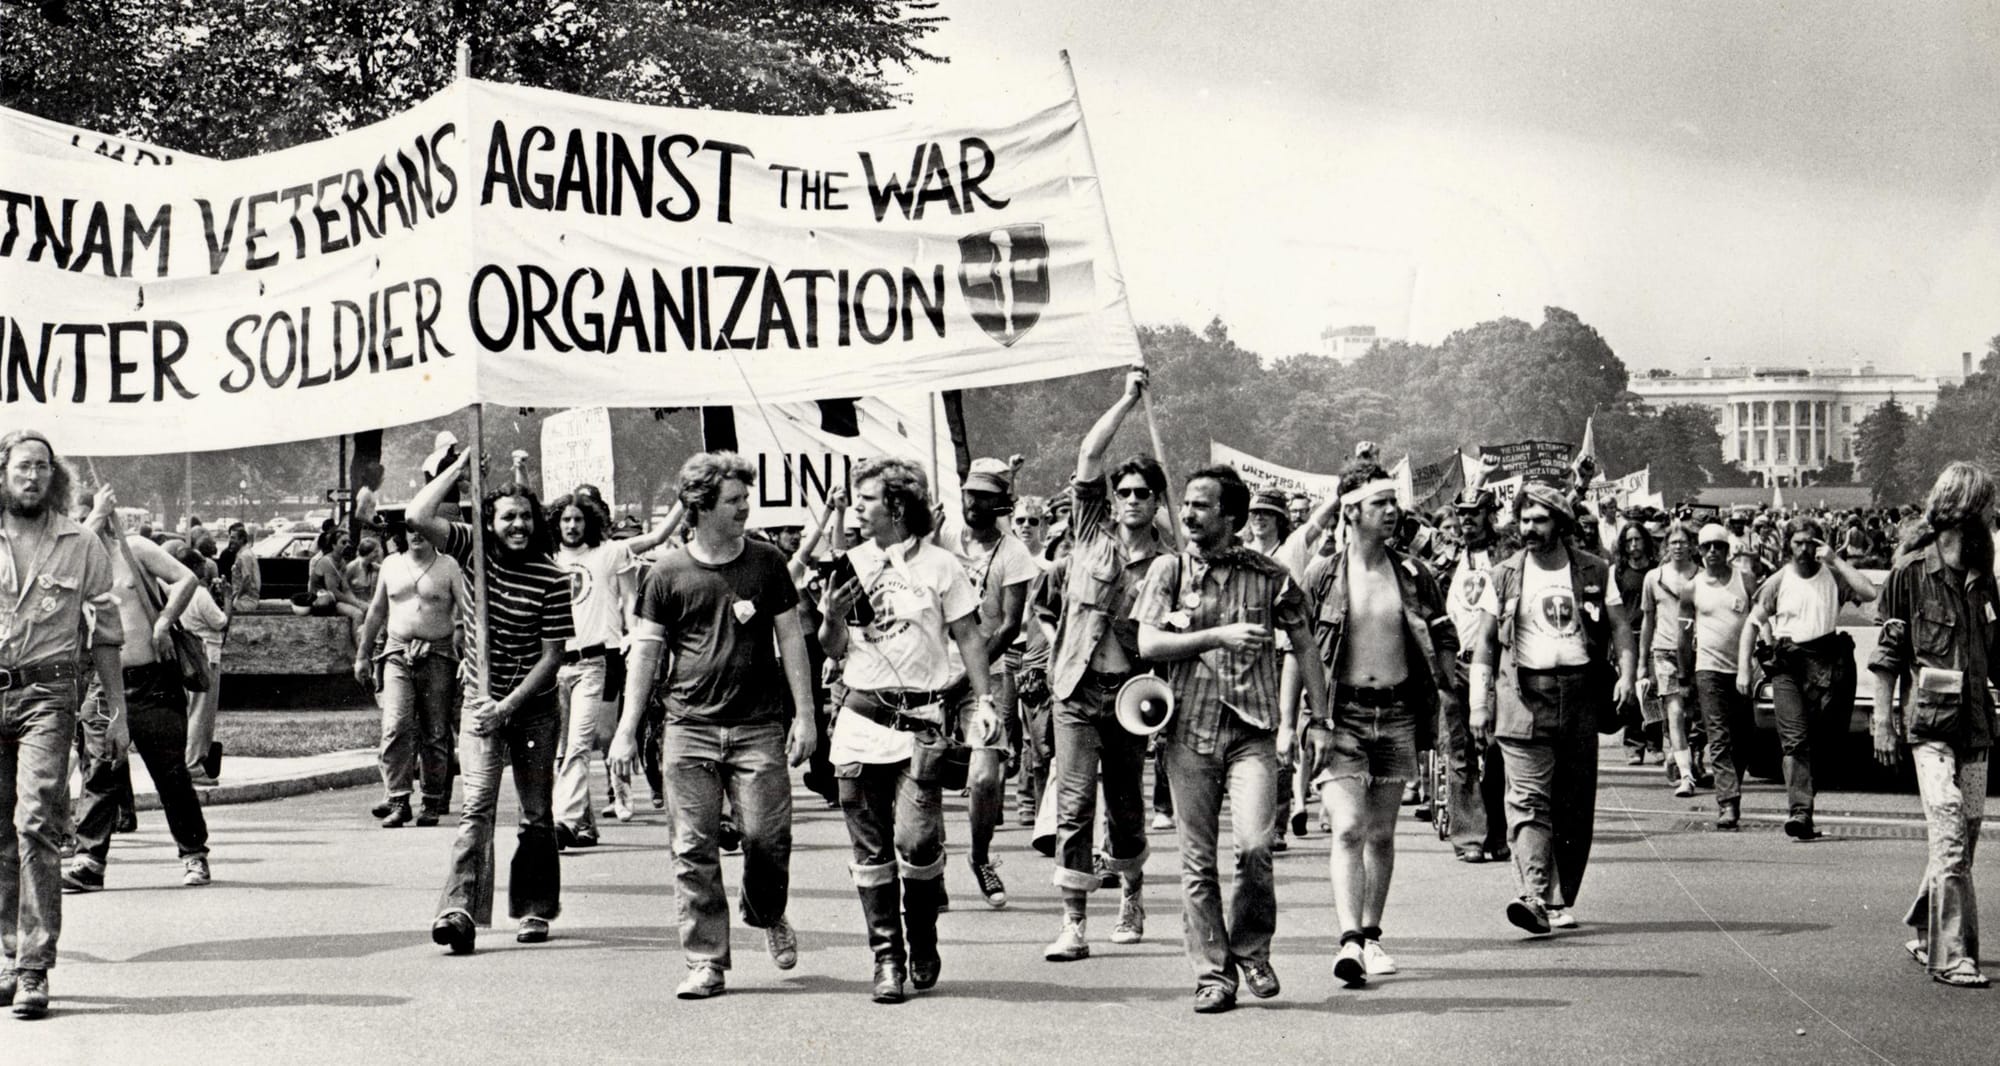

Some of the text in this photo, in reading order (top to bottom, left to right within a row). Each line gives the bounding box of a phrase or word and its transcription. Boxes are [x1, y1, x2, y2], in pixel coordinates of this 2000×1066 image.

[0, 119, 1011, 277] TNAM VETERANS AGAINST THE WAR
[219, 277, 455, 393] SOLDIER
[468, 263, 946, 355] ORGANIZATION
[758, 452, 867, 508] UNI
[1501, 453, 1530, 463] AGAINST
